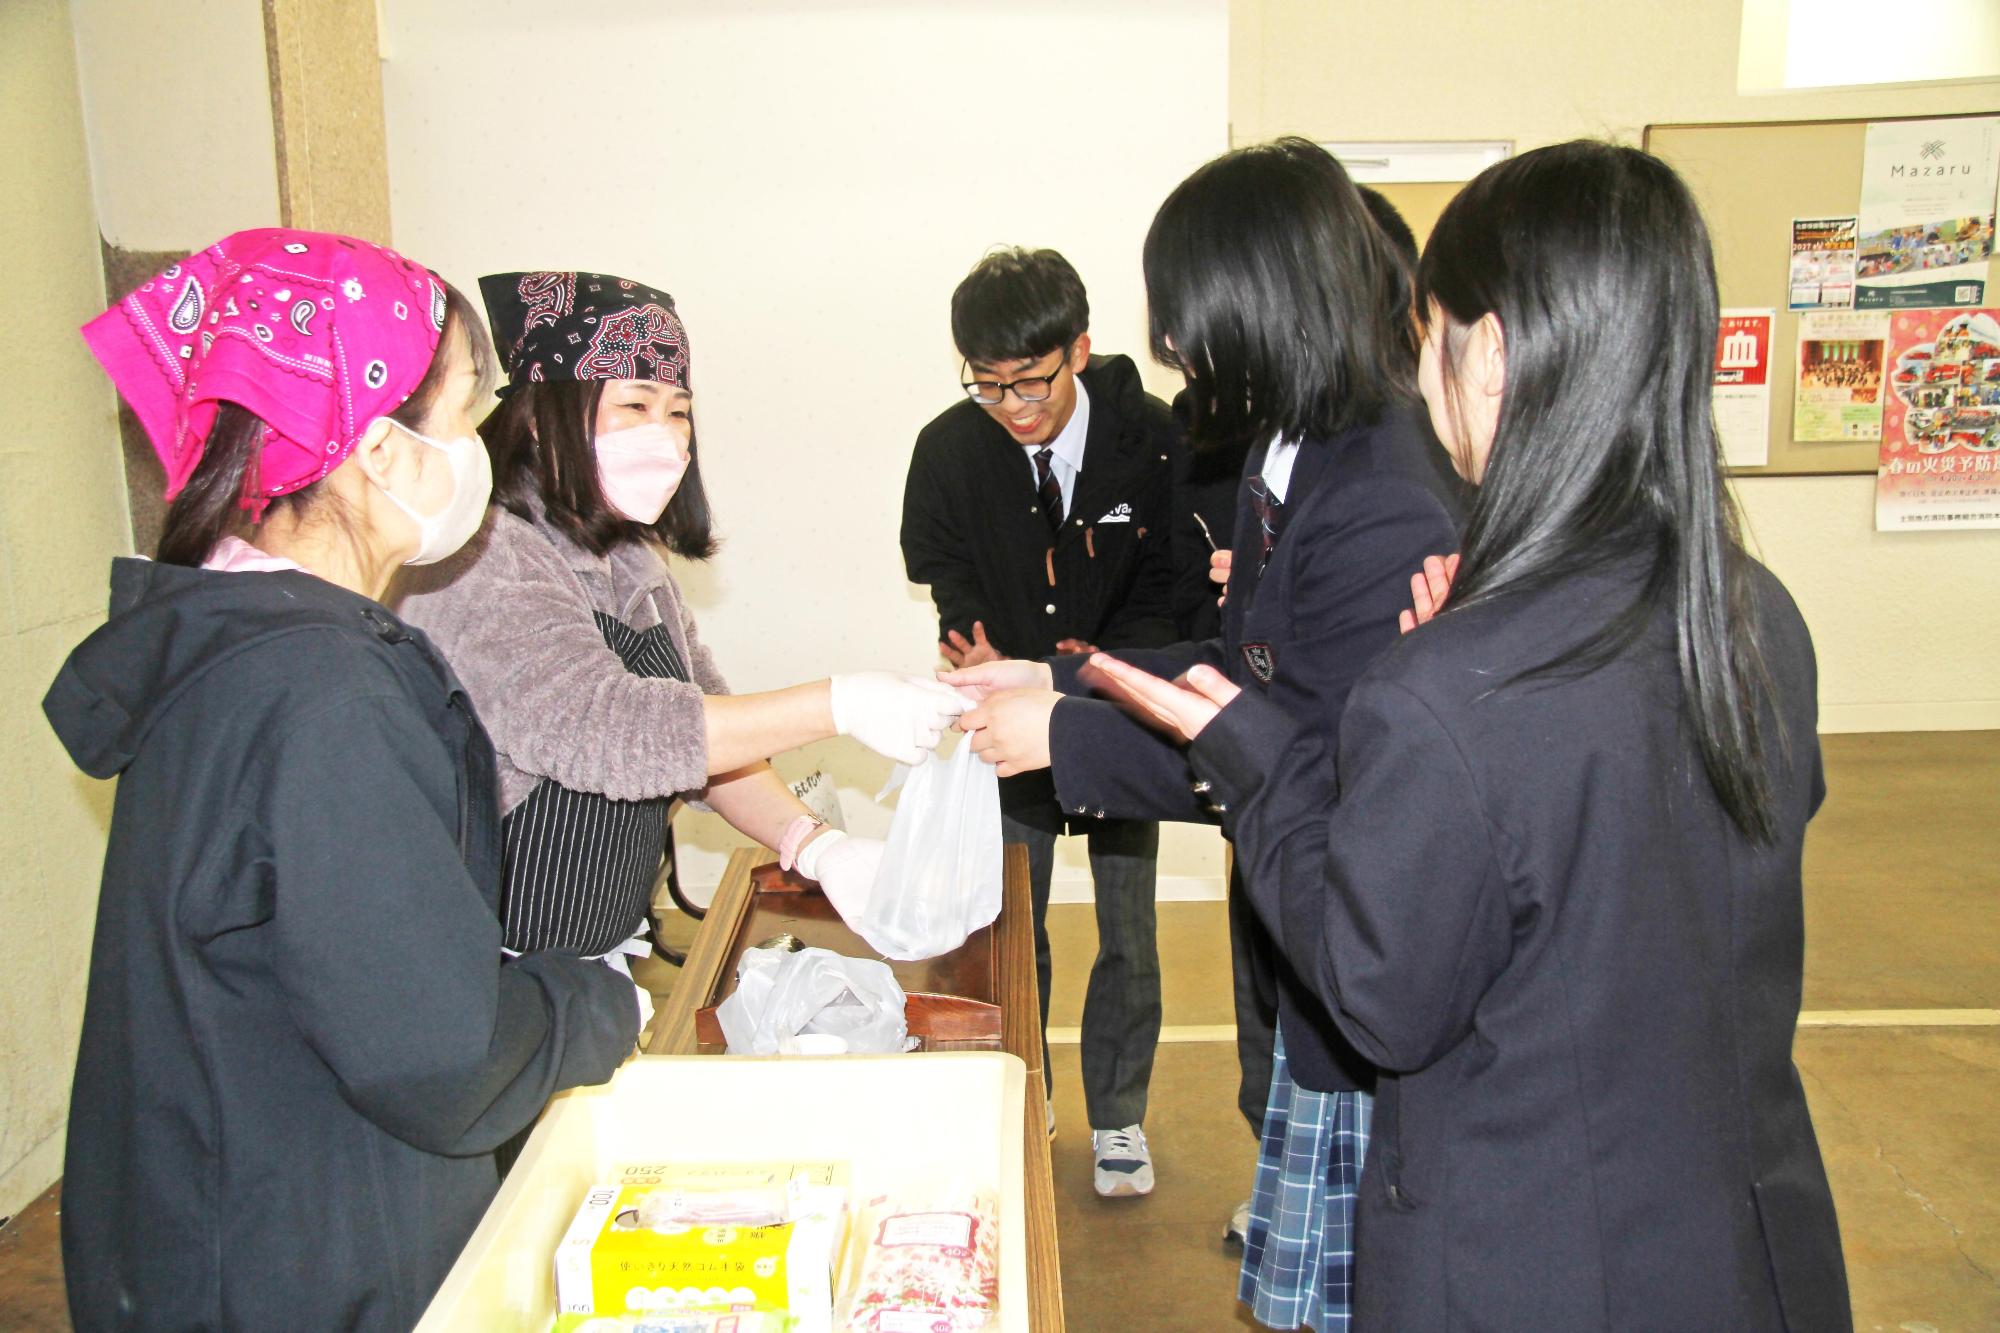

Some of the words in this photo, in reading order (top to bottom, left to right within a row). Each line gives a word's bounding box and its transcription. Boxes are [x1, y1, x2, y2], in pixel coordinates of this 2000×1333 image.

[1890, 164, 1971, 178] Mazaru
[1720, 331, 1759, 368] 血
[624, 1165, 668, 1176] 250
[588, 1190, 614, 1206] 100
